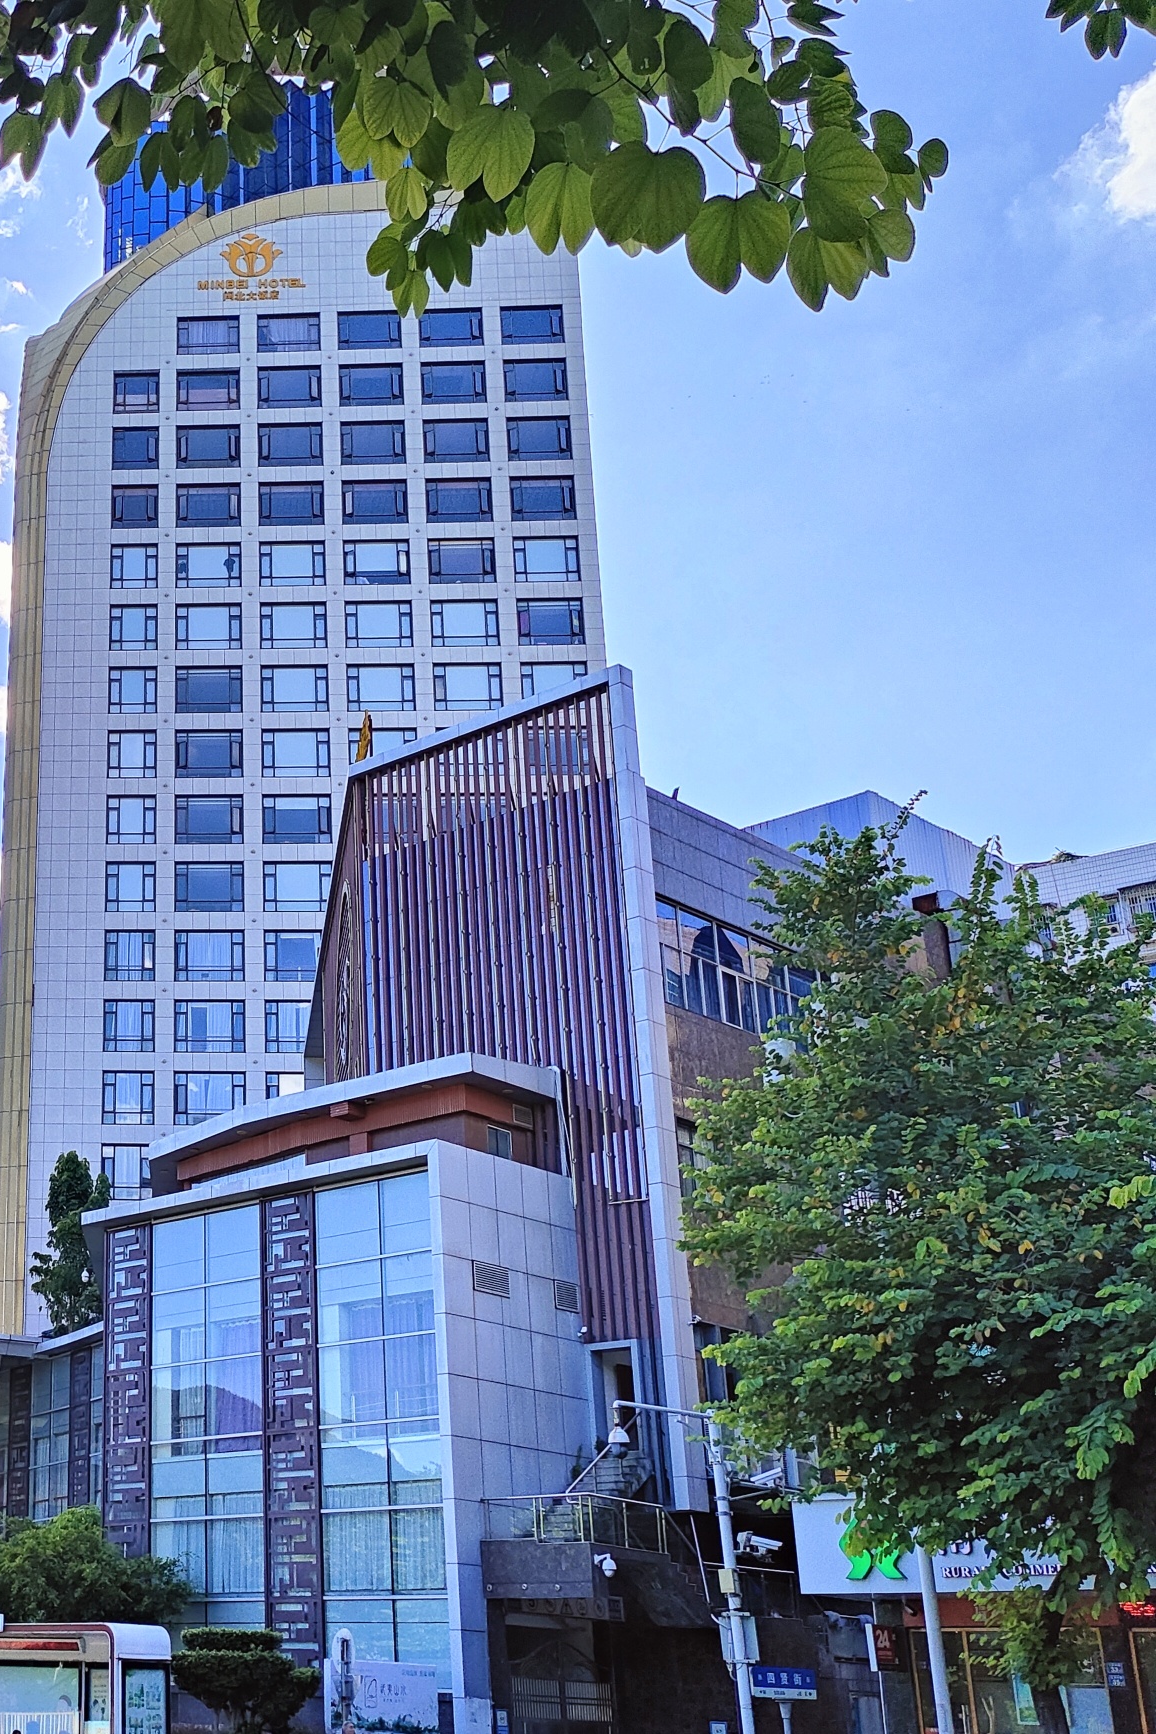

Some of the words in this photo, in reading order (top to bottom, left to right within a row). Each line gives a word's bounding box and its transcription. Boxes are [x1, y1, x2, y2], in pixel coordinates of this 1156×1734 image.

[197, 279, 249, 291] MINBEI
[257, 278, 307, 288] HOTEL
[222, 290, 280, 301] 闽北大饭店
